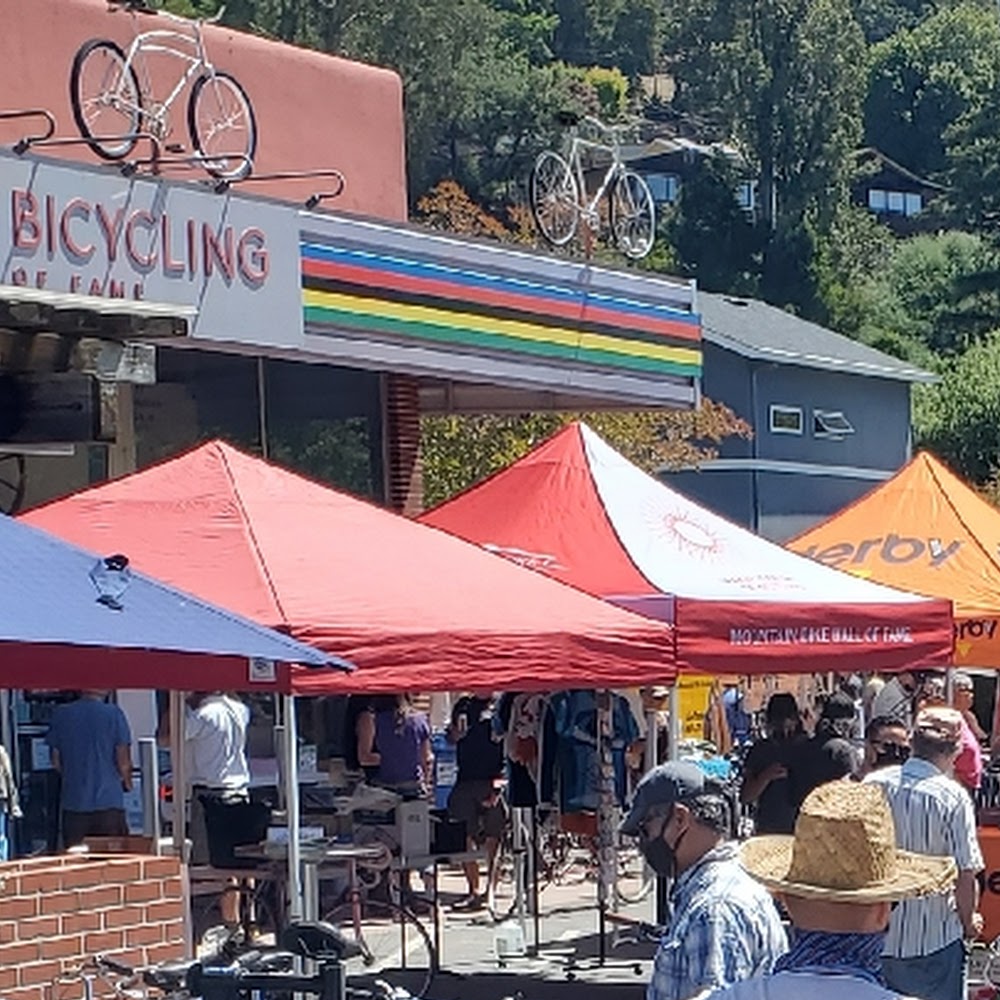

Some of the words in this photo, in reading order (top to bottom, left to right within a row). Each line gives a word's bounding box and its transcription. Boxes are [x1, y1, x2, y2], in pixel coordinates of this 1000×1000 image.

[11, 189, 270, 284] BICYCLING
[803, 533, 963, 568] erby
[729, 627, 798, 646] MOUNTAIN
[832, 626, 864, 644] HALL
[864, 626, 882, 644] OF
[883, 626, 914, 644] FAME
